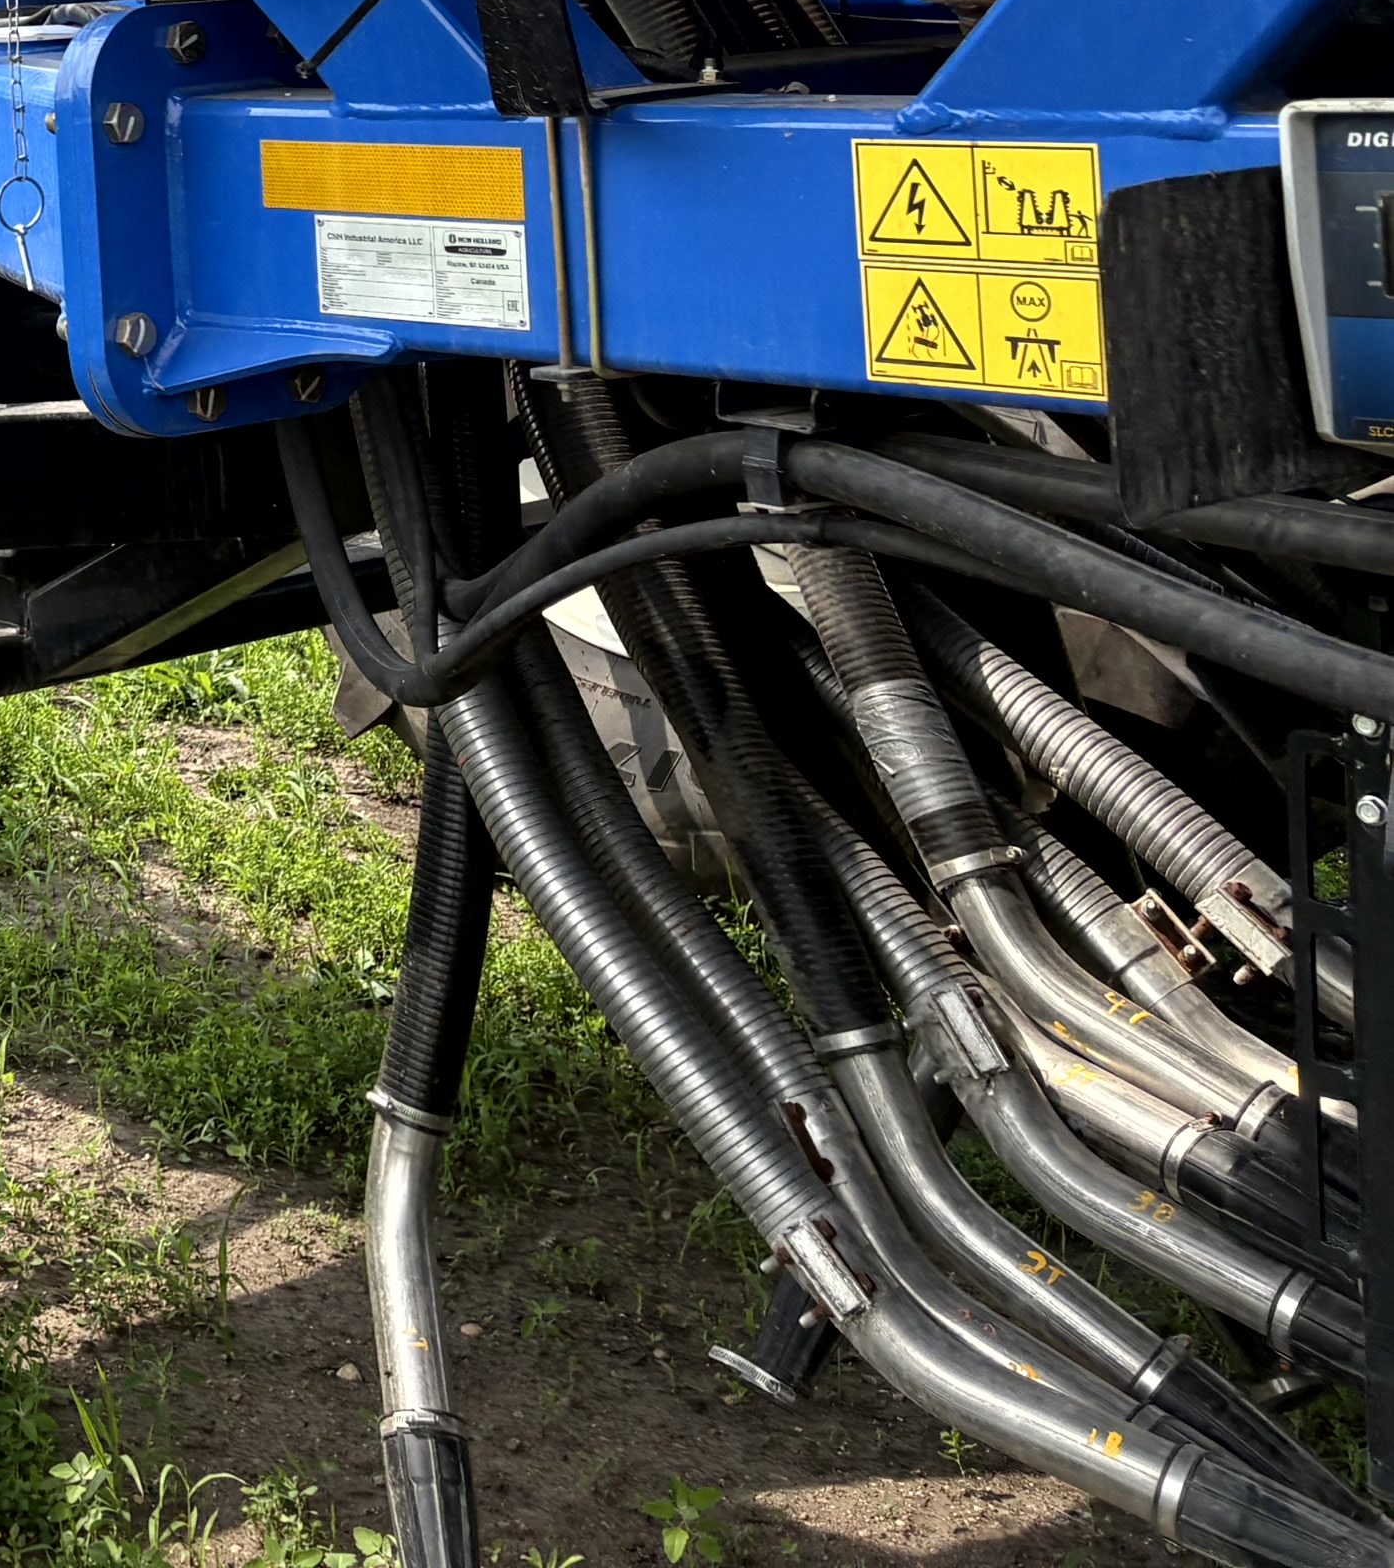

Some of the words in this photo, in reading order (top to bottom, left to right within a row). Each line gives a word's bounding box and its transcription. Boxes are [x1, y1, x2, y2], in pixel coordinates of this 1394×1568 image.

[344, 233, 376, 244] Industrial
[378, 236, 407, 245] America
[409, 237, 423, 246] LLC
[470, 278, 496, 286] Canada
[1016, 295, 1046, 308] MAX
[1019, 1250, 1066, 1286] 2T
